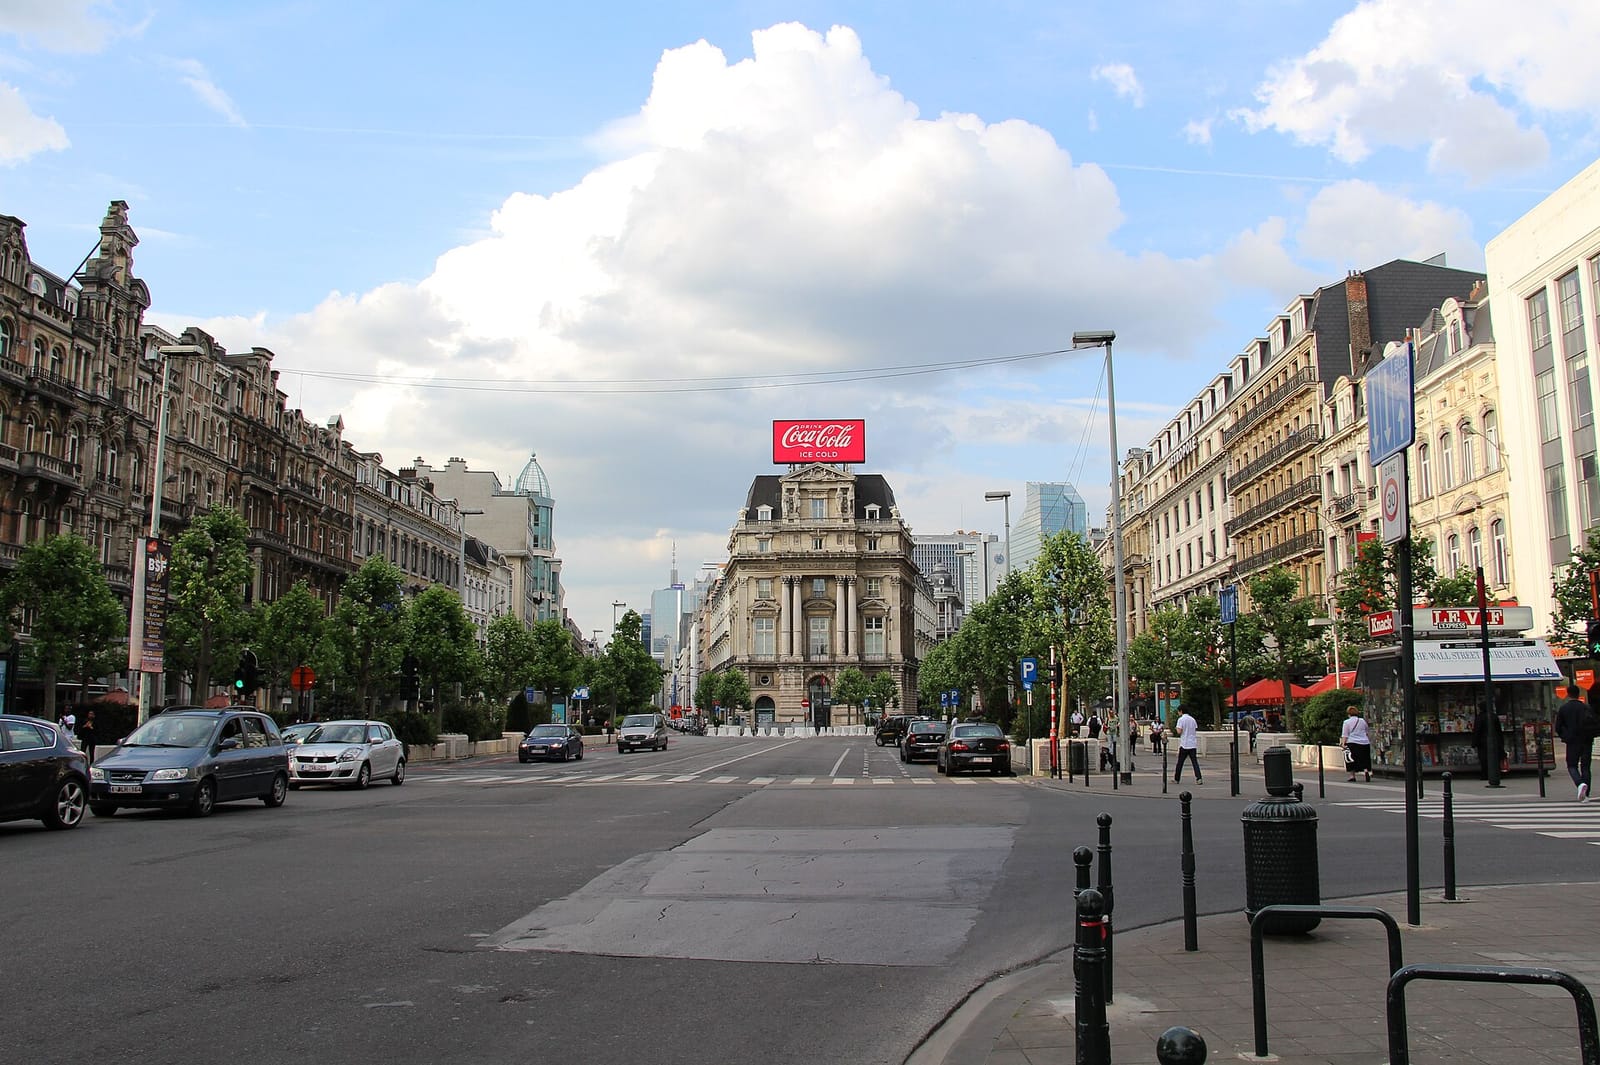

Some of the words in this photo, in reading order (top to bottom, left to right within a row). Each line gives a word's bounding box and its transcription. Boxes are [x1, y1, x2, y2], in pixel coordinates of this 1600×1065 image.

[1384, 463, 1396, 477] ZONE
[1386, 491, 1395, 509] 30
[148, 557, 167, 573] BSF
[1371, 614, 1393, 633] Knack
[1464, 610, 1502, 625] VF
[1415, 651, 1428, 661] HE
[1429, 651, 1450, 661] WALL
[1451, 650, 1481, 660] STREET
[1515, 649, 1549, 659] EUROPE
[1023, 661, 1035, 679] P
[1525, 667, 1541, 675] Get
[941, 693, 948, 702] P
[951, 690, 958, 700] P
